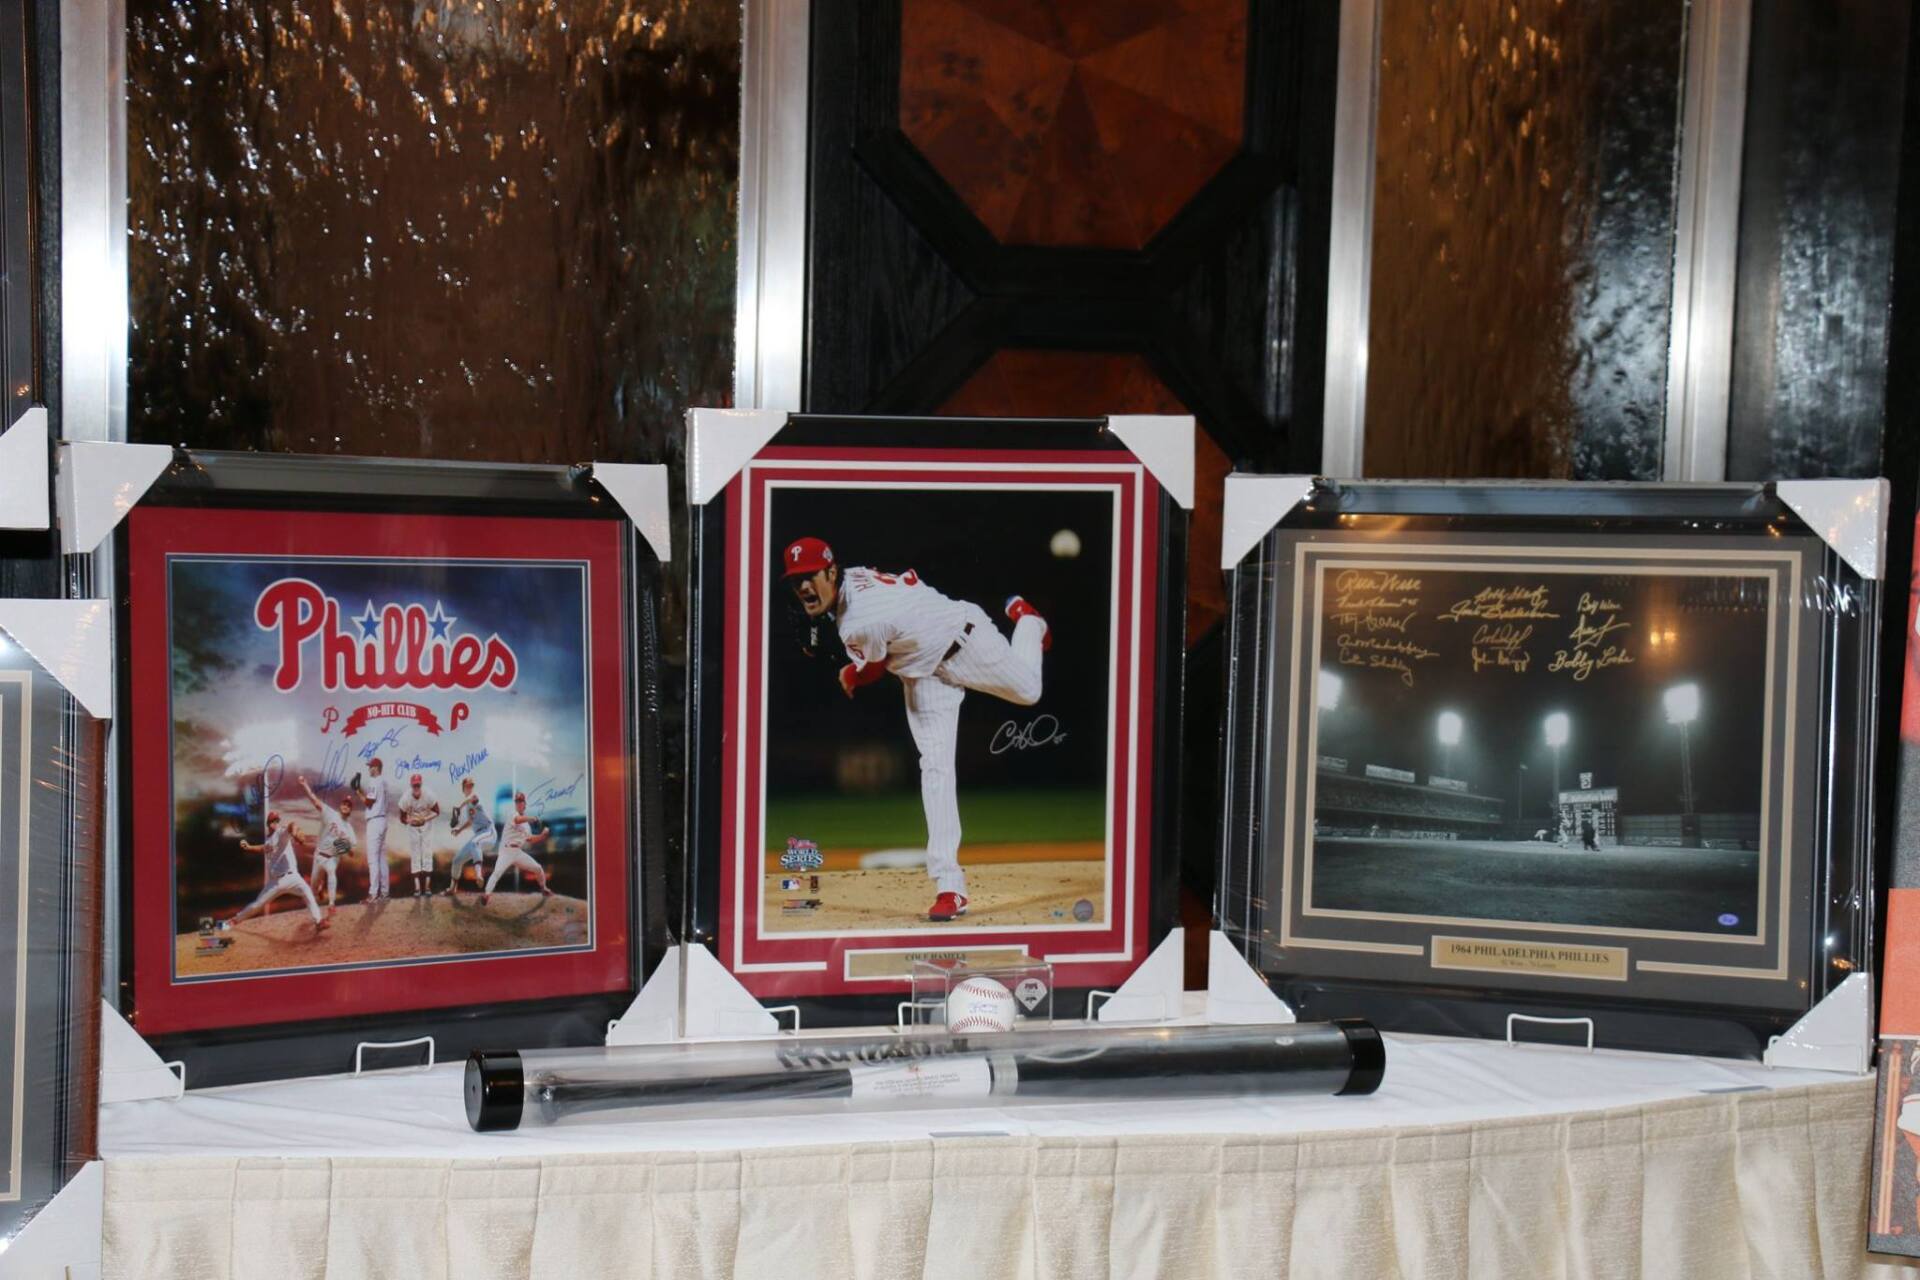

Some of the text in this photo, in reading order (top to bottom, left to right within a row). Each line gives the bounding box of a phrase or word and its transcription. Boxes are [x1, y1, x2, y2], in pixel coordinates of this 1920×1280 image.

[791, 545, 803, 562] P
[255, 577, 518, 692] Phillies
[367, 703, 417, 718] NO-HIT CLUB
[780, 854, 823, 866] SERIES
[1450, 943, 1610, 963] 1964 PHILADELPHIA PHILLIES
